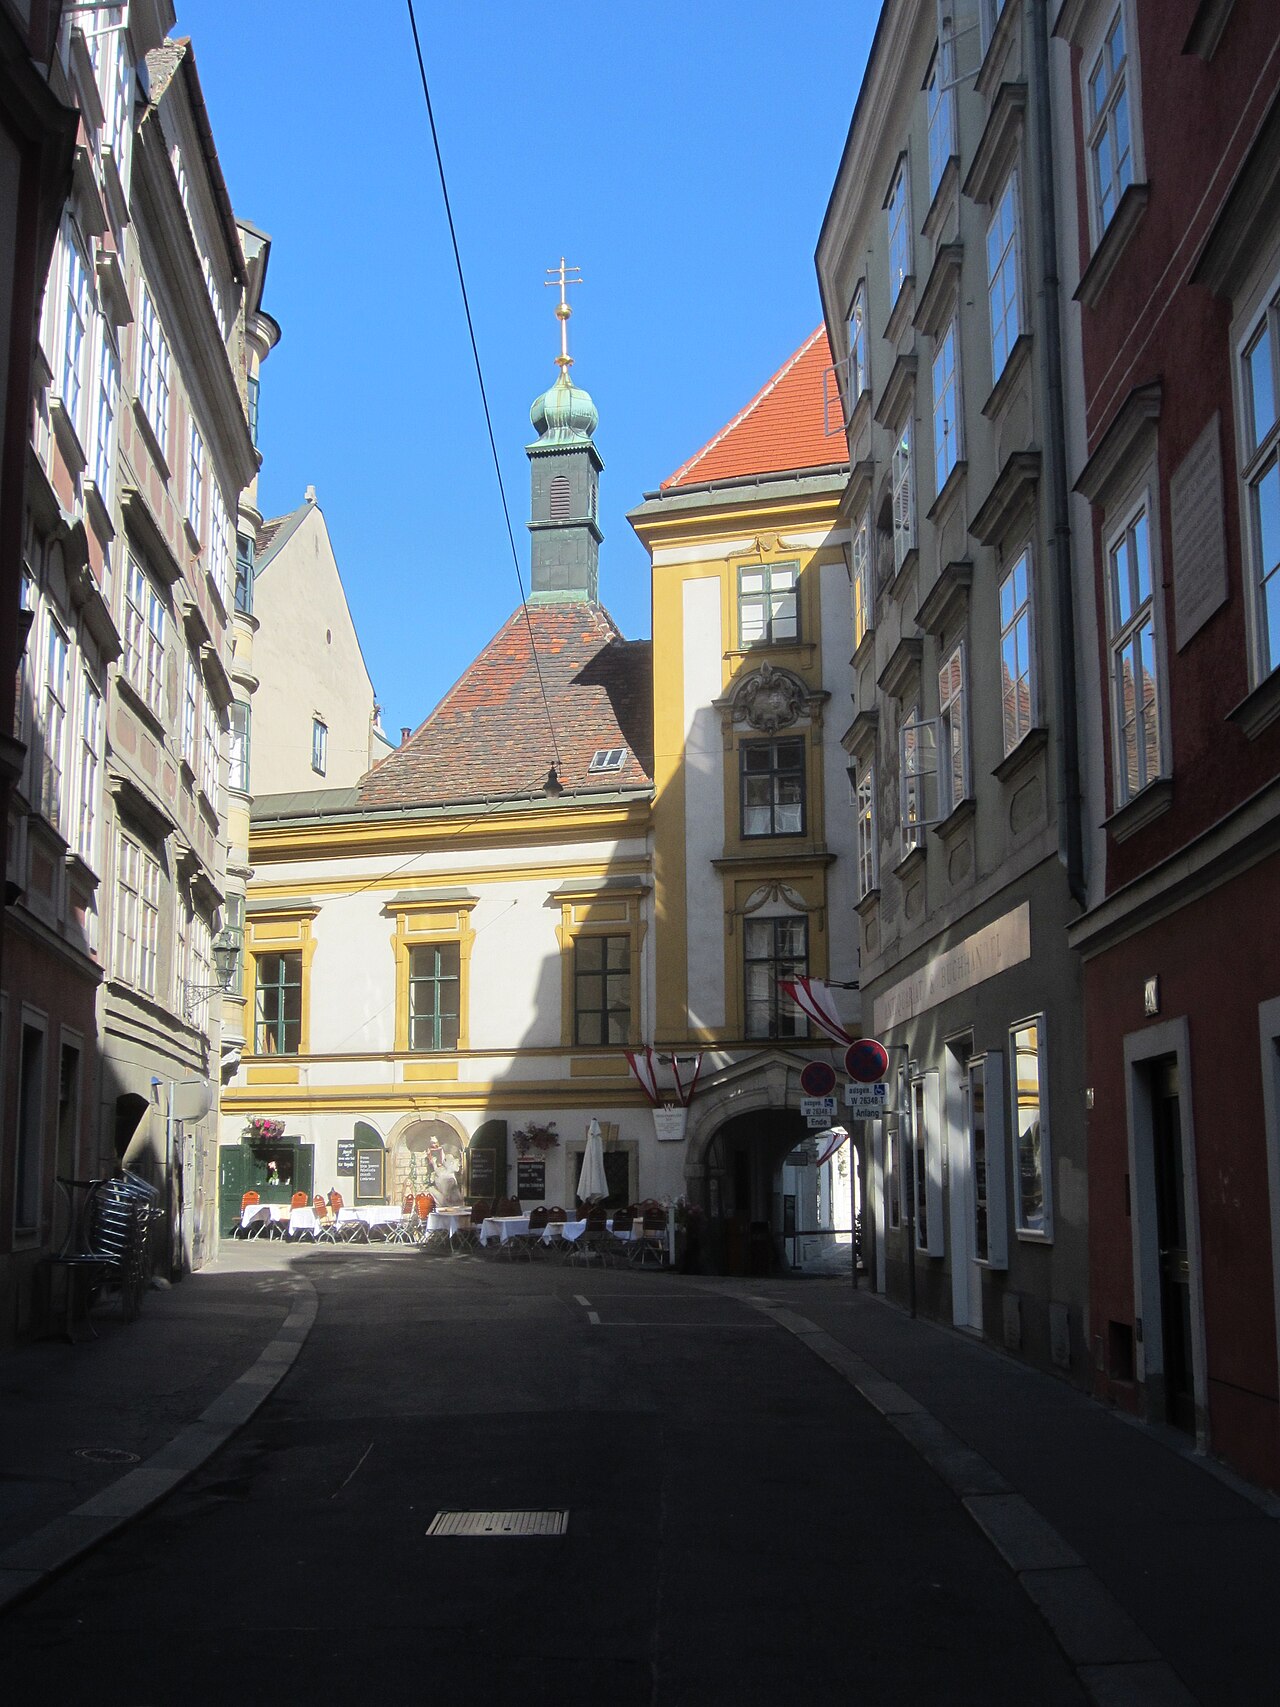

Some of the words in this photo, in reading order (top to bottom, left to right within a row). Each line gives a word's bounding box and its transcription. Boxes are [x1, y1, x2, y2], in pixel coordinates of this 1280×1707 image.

[850, 1097, 858, 1105] W
[856, 1109, 880, 1119] Anfang
[811, 1118, 828, 1126] Ende
